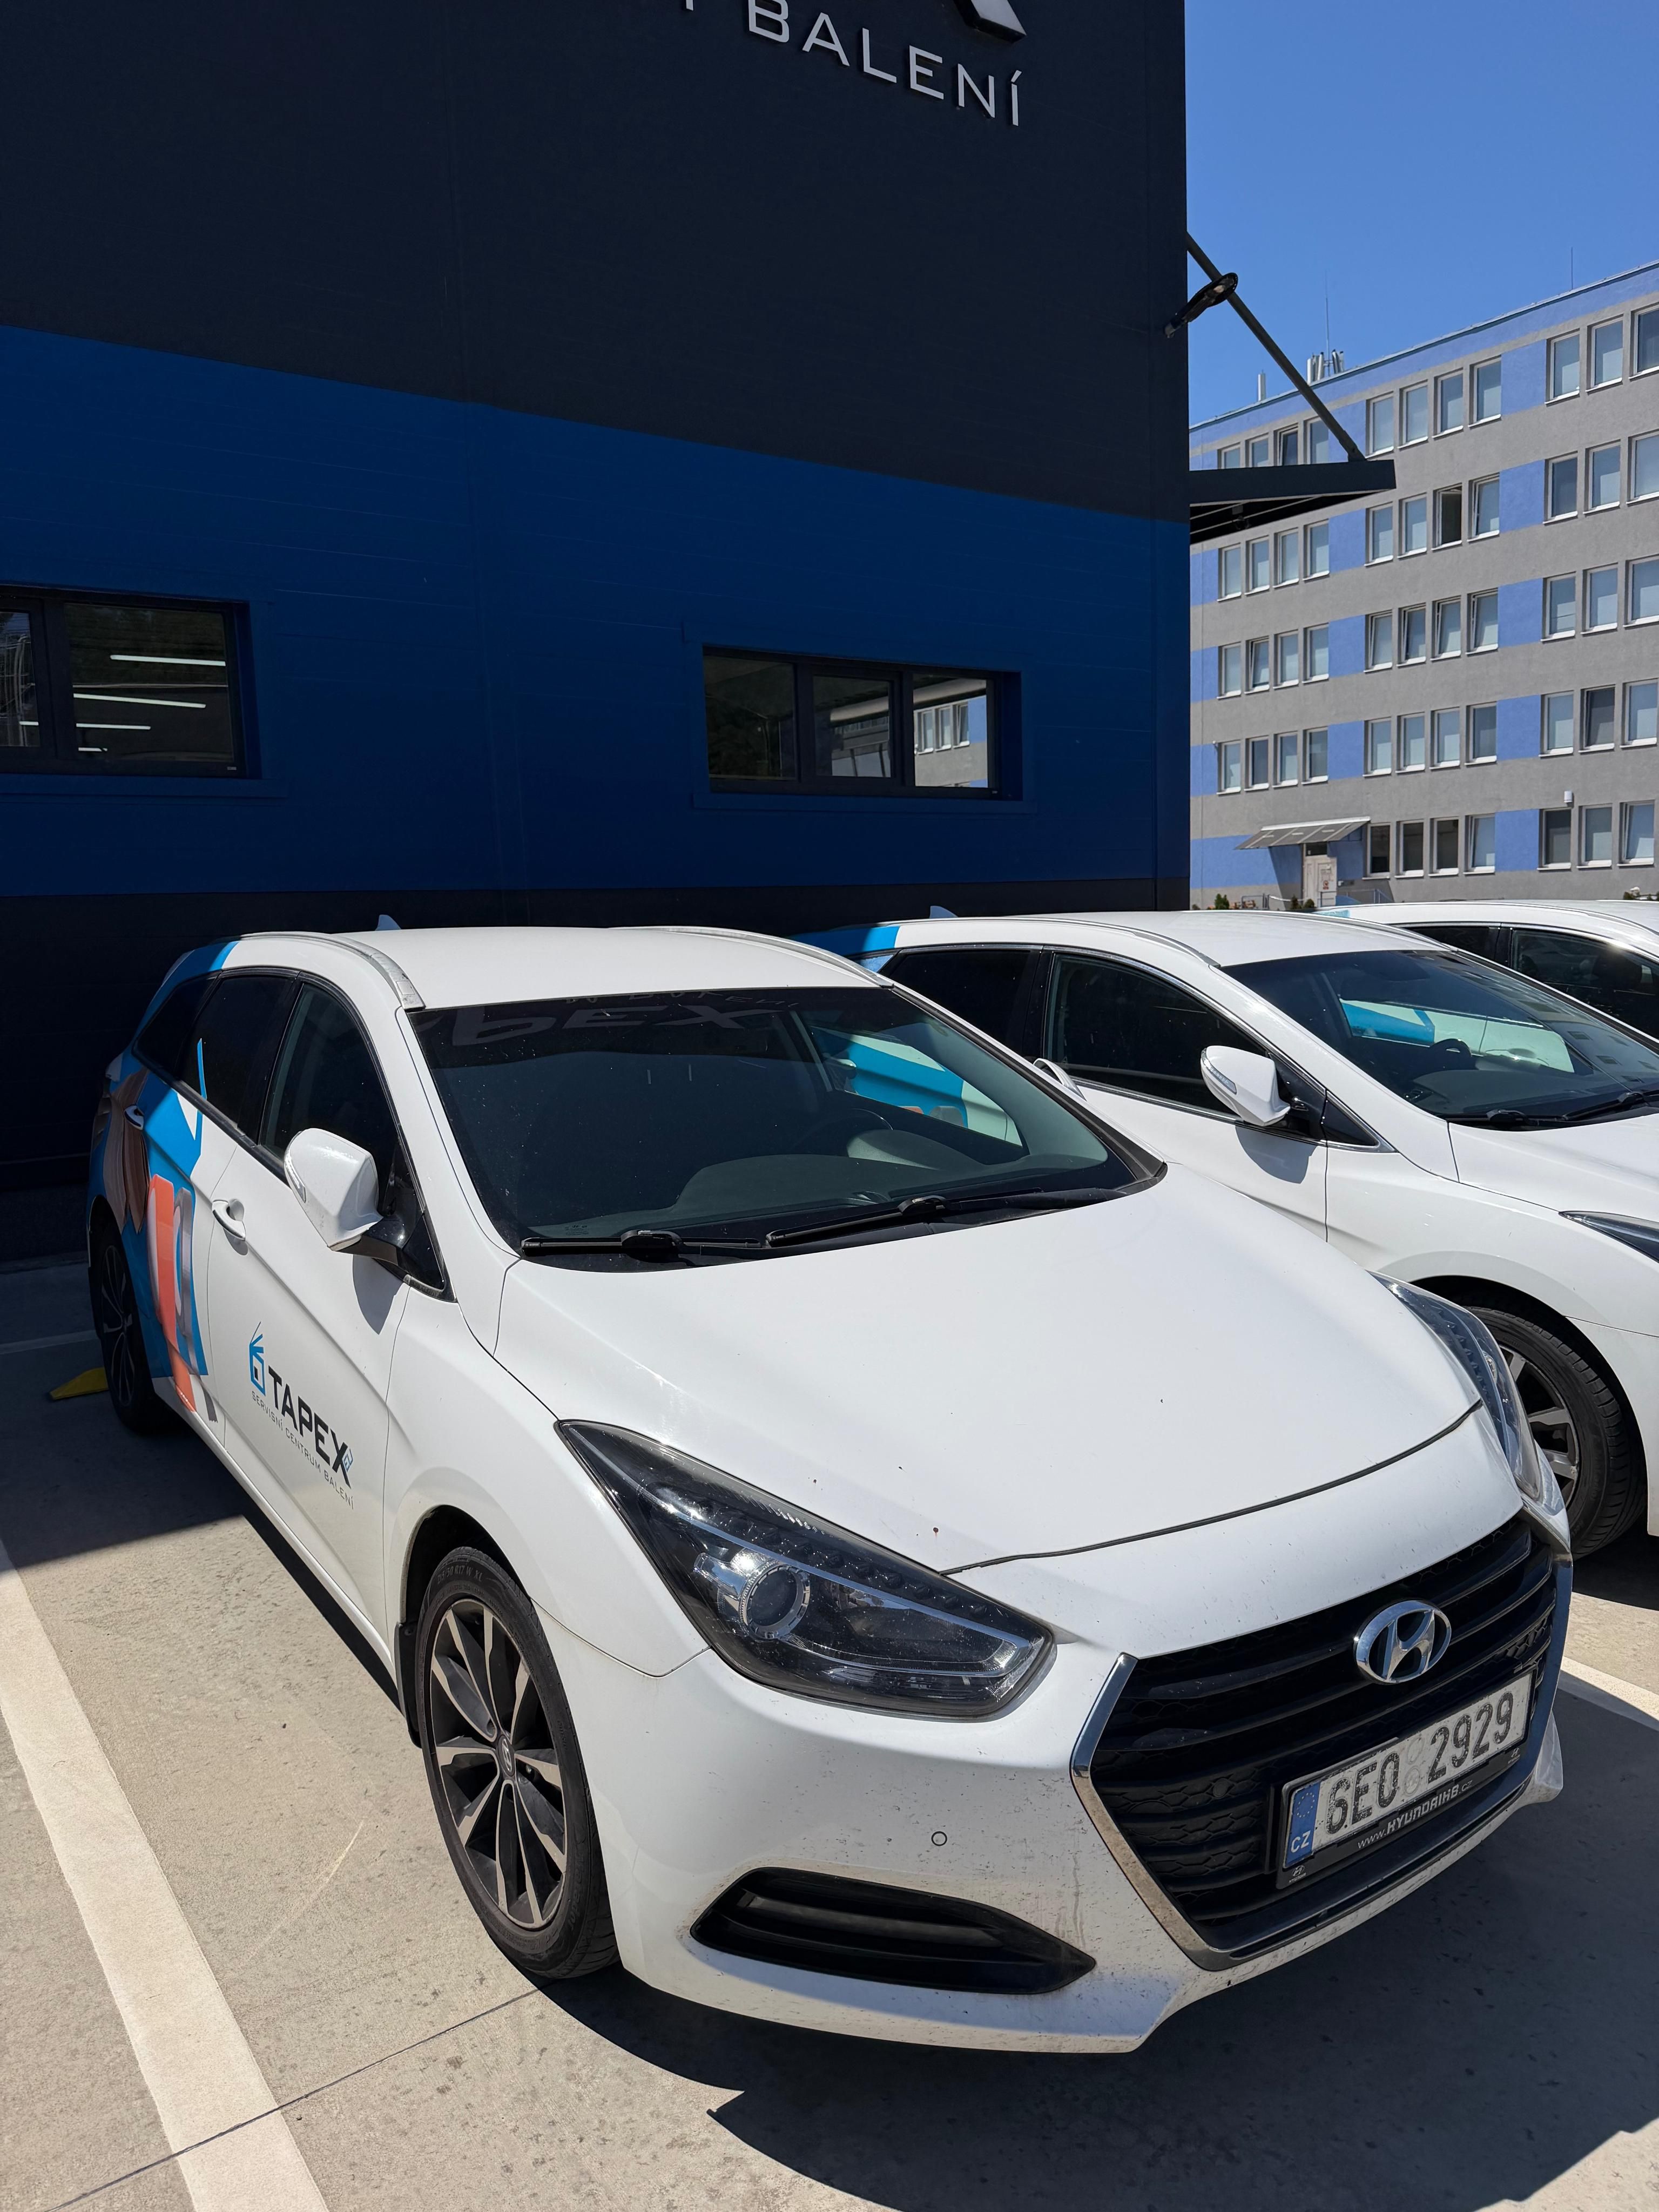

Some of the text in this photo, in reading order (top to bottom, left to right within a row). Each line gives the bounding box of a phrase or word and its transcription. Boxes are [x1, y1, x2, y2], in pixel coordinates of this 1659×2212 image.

[748, 0, 1022, 126] BALENÍ
[252, 1391, 354, 1510] SERVISNÍ CENTRUM BALENÍ
[268, 1365, 351, 1489] TAPEX
[1326, 1691, 1513, 1835] 6E0 2929
[1291, 1830, 1311, 1853] CZ
